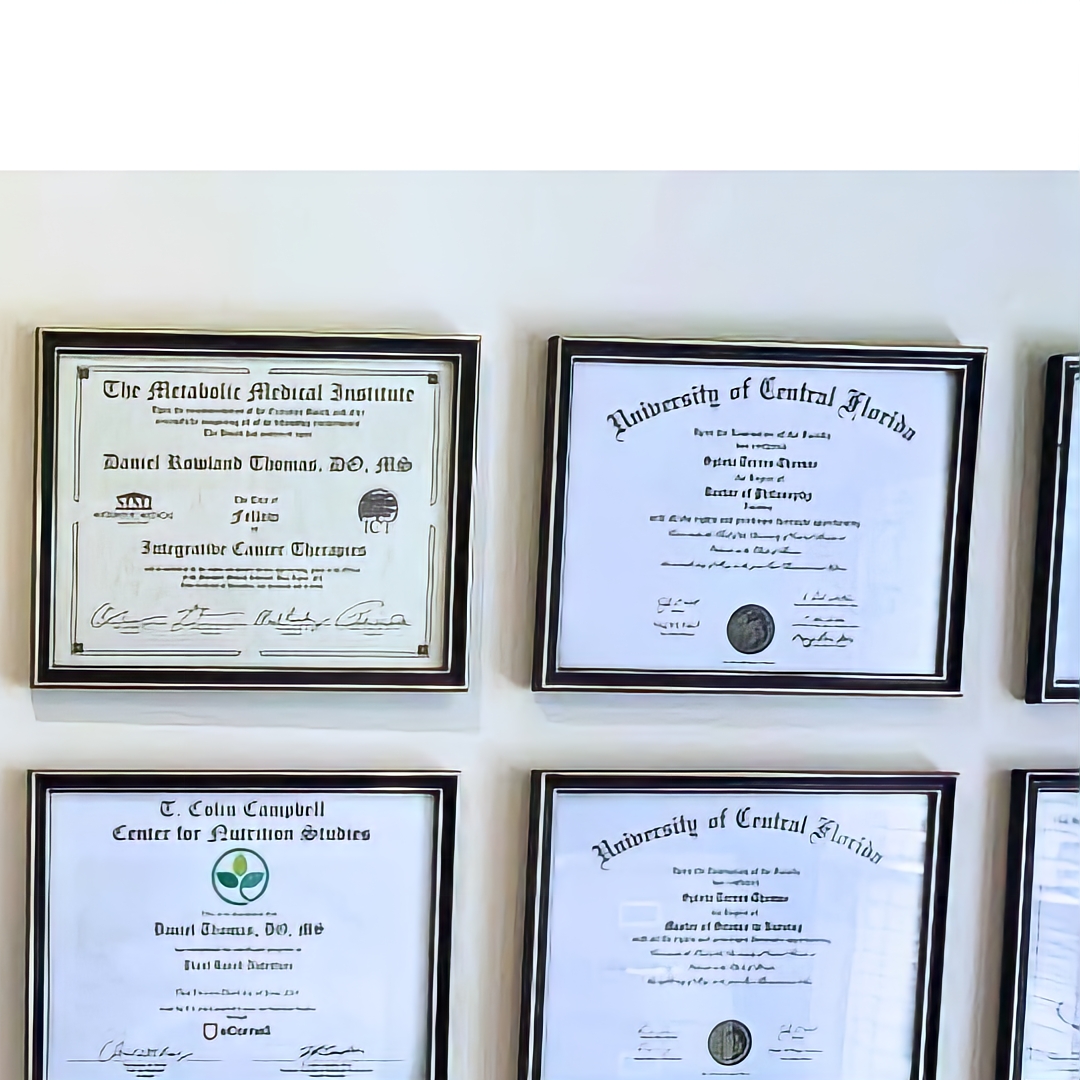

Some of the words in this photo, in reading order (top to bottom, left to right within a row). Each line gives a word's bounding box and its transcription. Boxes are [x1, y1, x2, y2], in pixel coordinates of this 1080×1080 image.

[104, 380, 140, 399] The
[147, 381, 240, 400] Metabolic
[247, 382, 322, 402] Medical
[330, 383, 414, 402] Institute
[607, 385, 720, 442] University
[730, 377, 751, 400] of
[760, 377, 836, 406] Central
[838, 389, 915, 441] Florida
[104, 454, 159, 469] Daniel
[168, 454, 242, 470] Rowland
[375, 457, 412, 473] MS
[142, 541, 226, 558] Integrative
[232, 542, 284, 556] Cancer
[292, 542, 366, 557] Therapies
[160, 801, 180, 817] T.
[189, 801, 235, 817] Colin
[244, 801, 324, 818] Campbell
[113, 825, 170, 840] Center
[178, 826, 201, 840] for
[208, 825, 293, 842] Nutrition
[301, 825, 370, 840] Studies
[592, 815, 698, 871] University
[709, 808, 728, 828] of
[736, 807, 807, 834] Central
[810, 817, 882, 863] Florida
